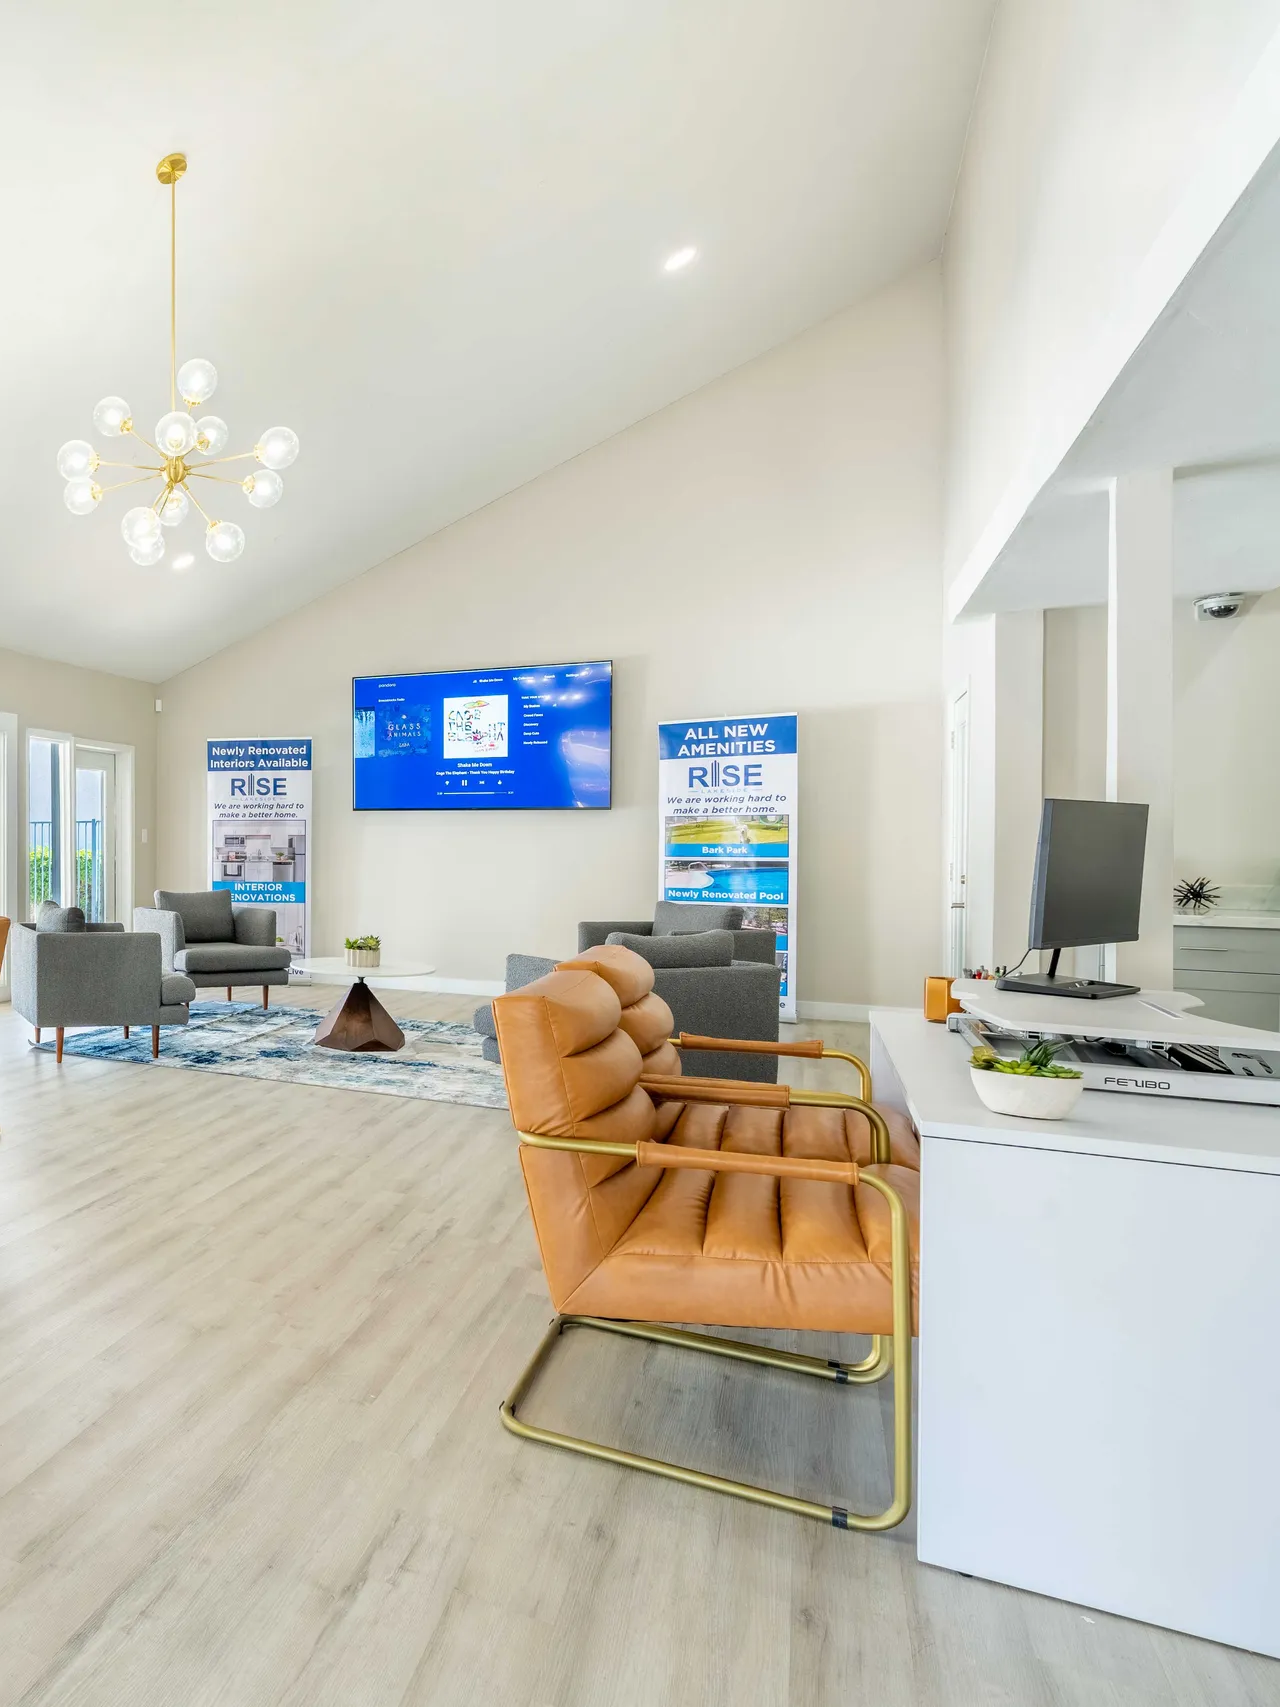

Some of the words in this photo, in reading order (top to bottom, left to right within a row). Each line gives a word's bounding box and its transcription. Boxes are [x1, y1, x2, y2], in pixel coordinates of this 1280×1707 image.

[388, 723, 421, 731] GLASS
[685, 726, 718, 740] ALL
[724, 724, 768, 738] NEW
[212, 746, 245, 756] Newly
[248, 745, 307, 755] Renovated
[678, 740, 776, 757] AMENITIES
[210, 759, 255, 768] Interiors
[257, 758, 308, 767] Available
[689, 760, 763, 788] RISE
[231, 773, 287, 796] RISE
[705, 795, 745, 804] working
[748, 794, 772, 802] hard
[711, 806, 743, 814] better
[702, 846, 724, 854] Bark
[726, 846, 748, 854] Park
[234, 883, 283, 891] INTERIOR
[231, 893, 296, 902] ENOVATIONS
[668, 889, 699, 899] Newly
[702, 890, 756, 900] Renovated
[759, 891, 784, 900] Pool
